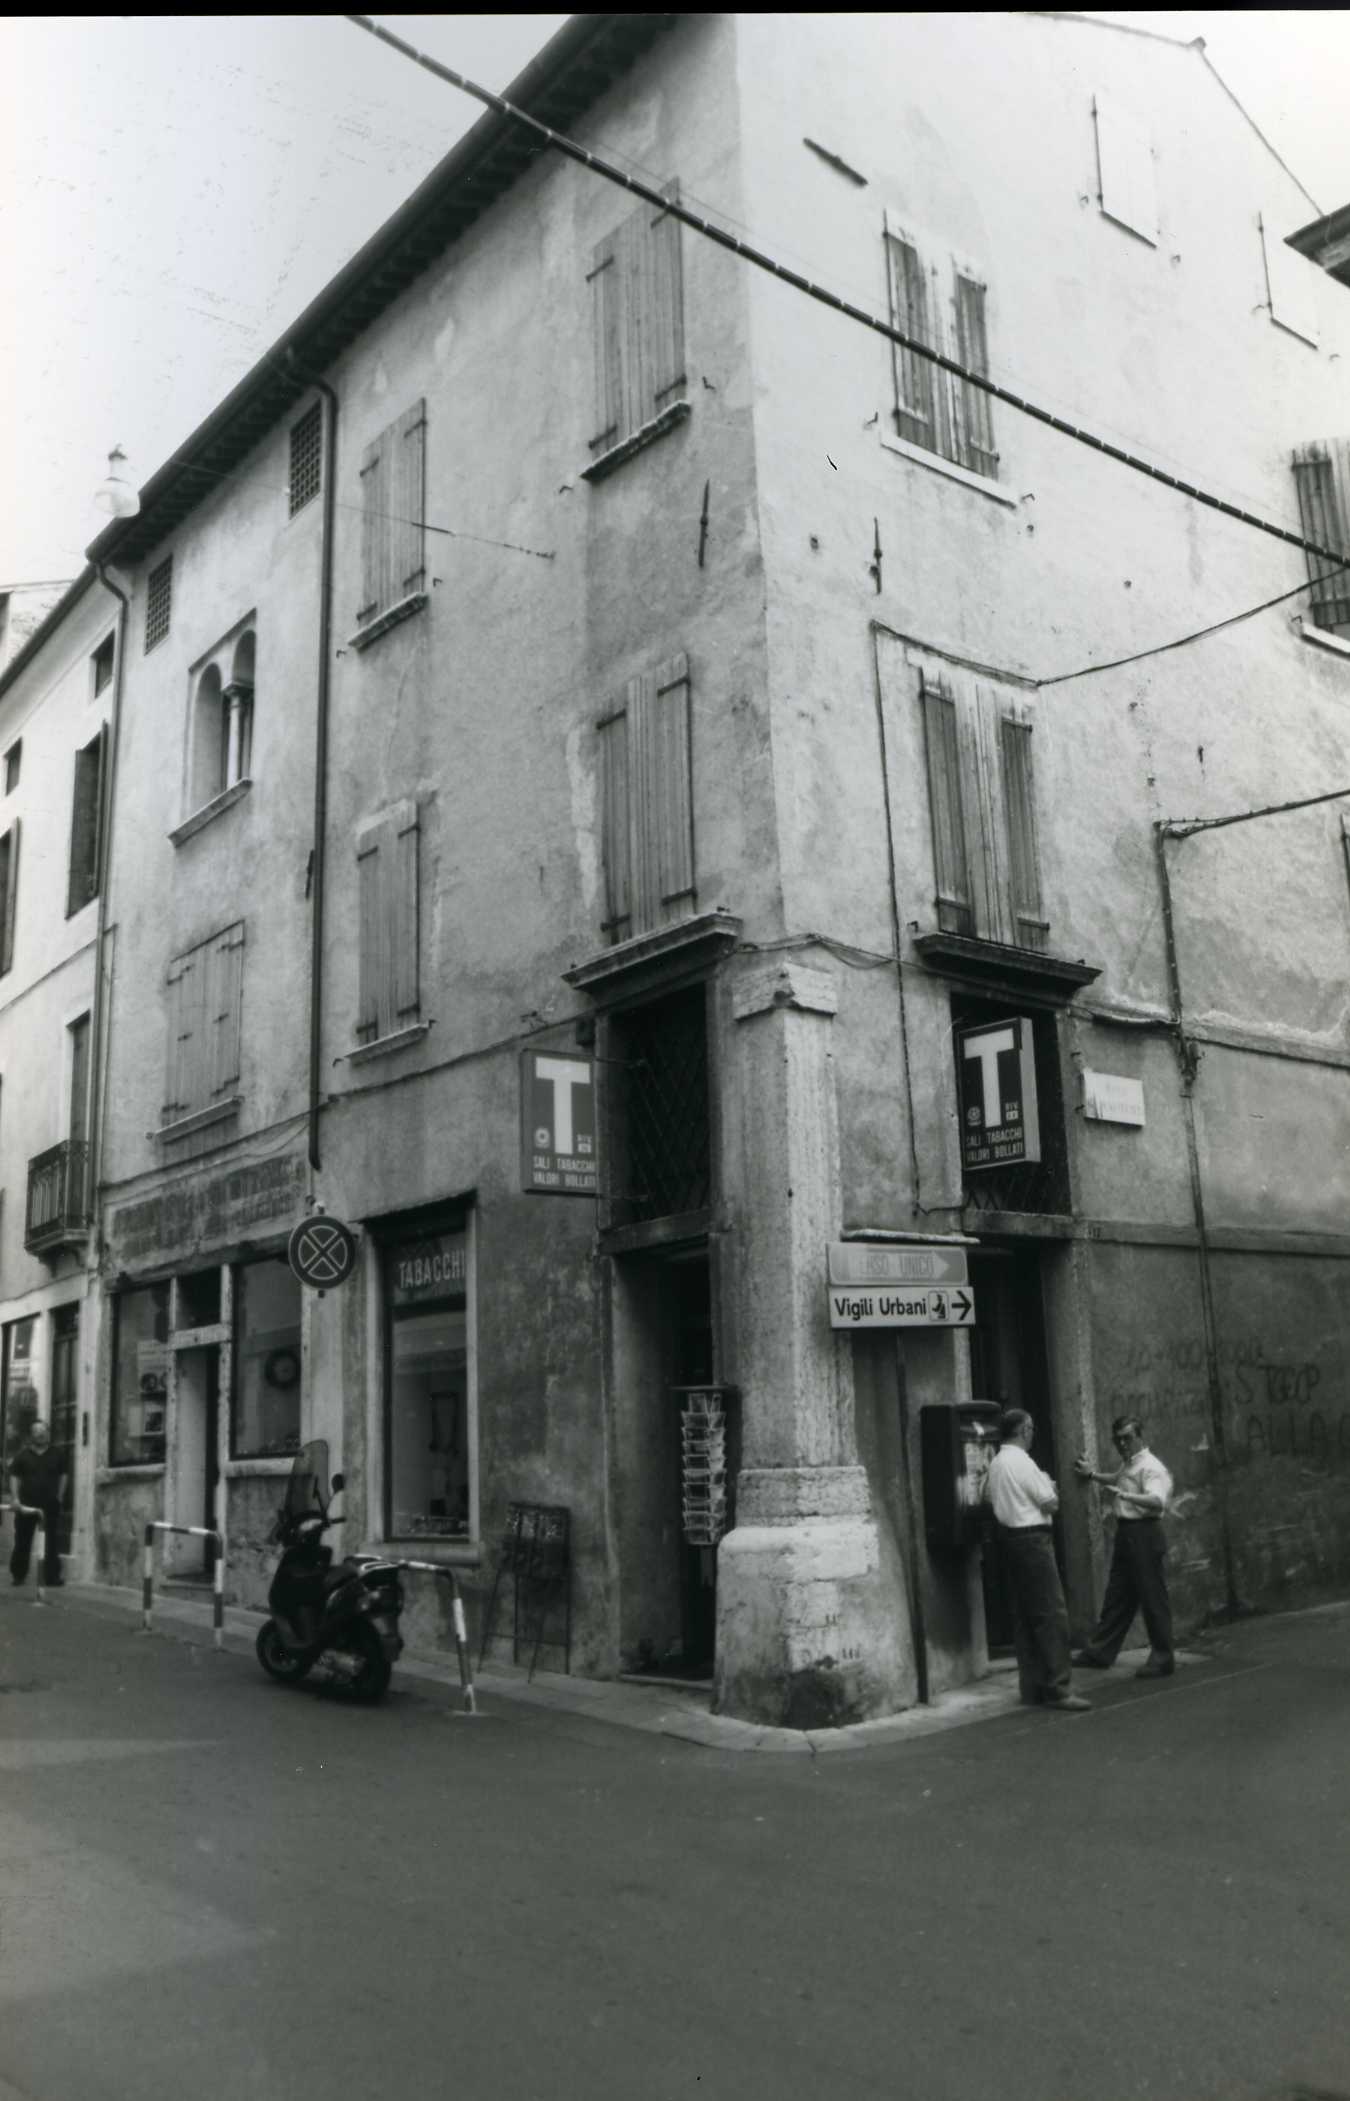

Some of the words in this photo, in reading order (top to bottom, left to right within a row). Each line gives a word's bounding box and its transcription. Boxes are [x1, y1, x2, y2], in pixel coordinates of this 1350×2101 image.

[964, 1028, 1014, 1128] T
[536, 1057, 591, 1155] T
[399, 1248, 465, 1289] TABACCHI
[899, 1255, 935, 1277] UNICO
[834, 1297, 873, 1321] Vigili
[879, 1297, 927, 1316] Urbani
